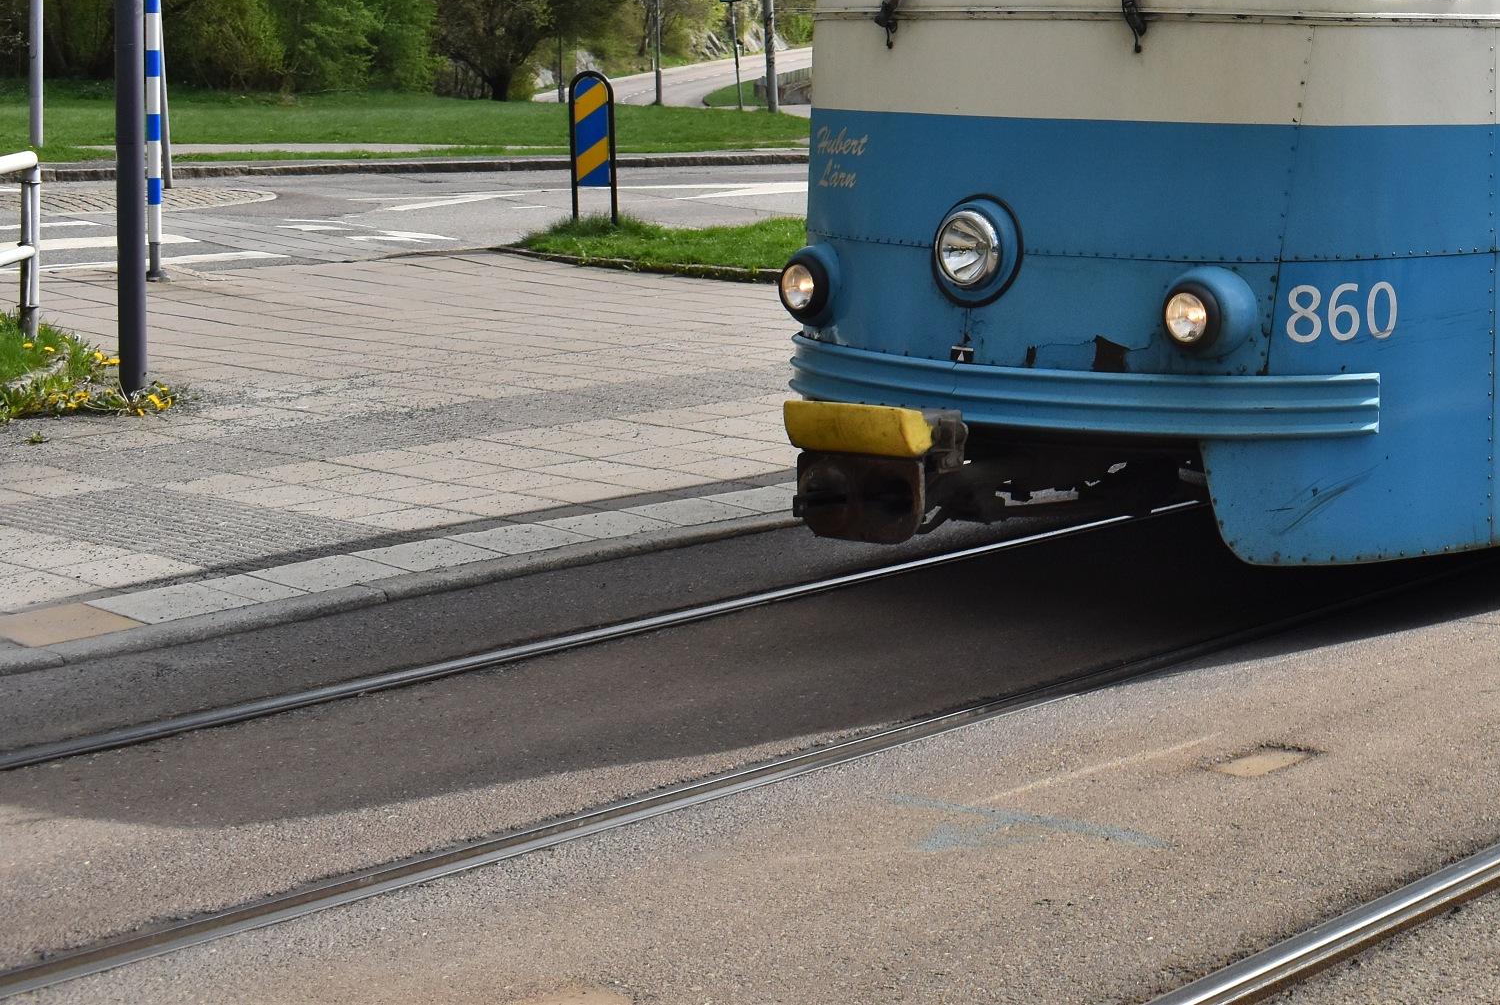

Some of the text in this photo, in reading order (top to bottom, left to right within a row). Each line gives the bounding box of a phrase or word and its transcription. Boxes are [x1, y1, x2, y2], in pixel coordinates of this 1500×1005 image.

[817, 126, 868, 156] Hubert
[818, 159, 856, 188] Lärn
[1286, 281, 1398, 343] 860
